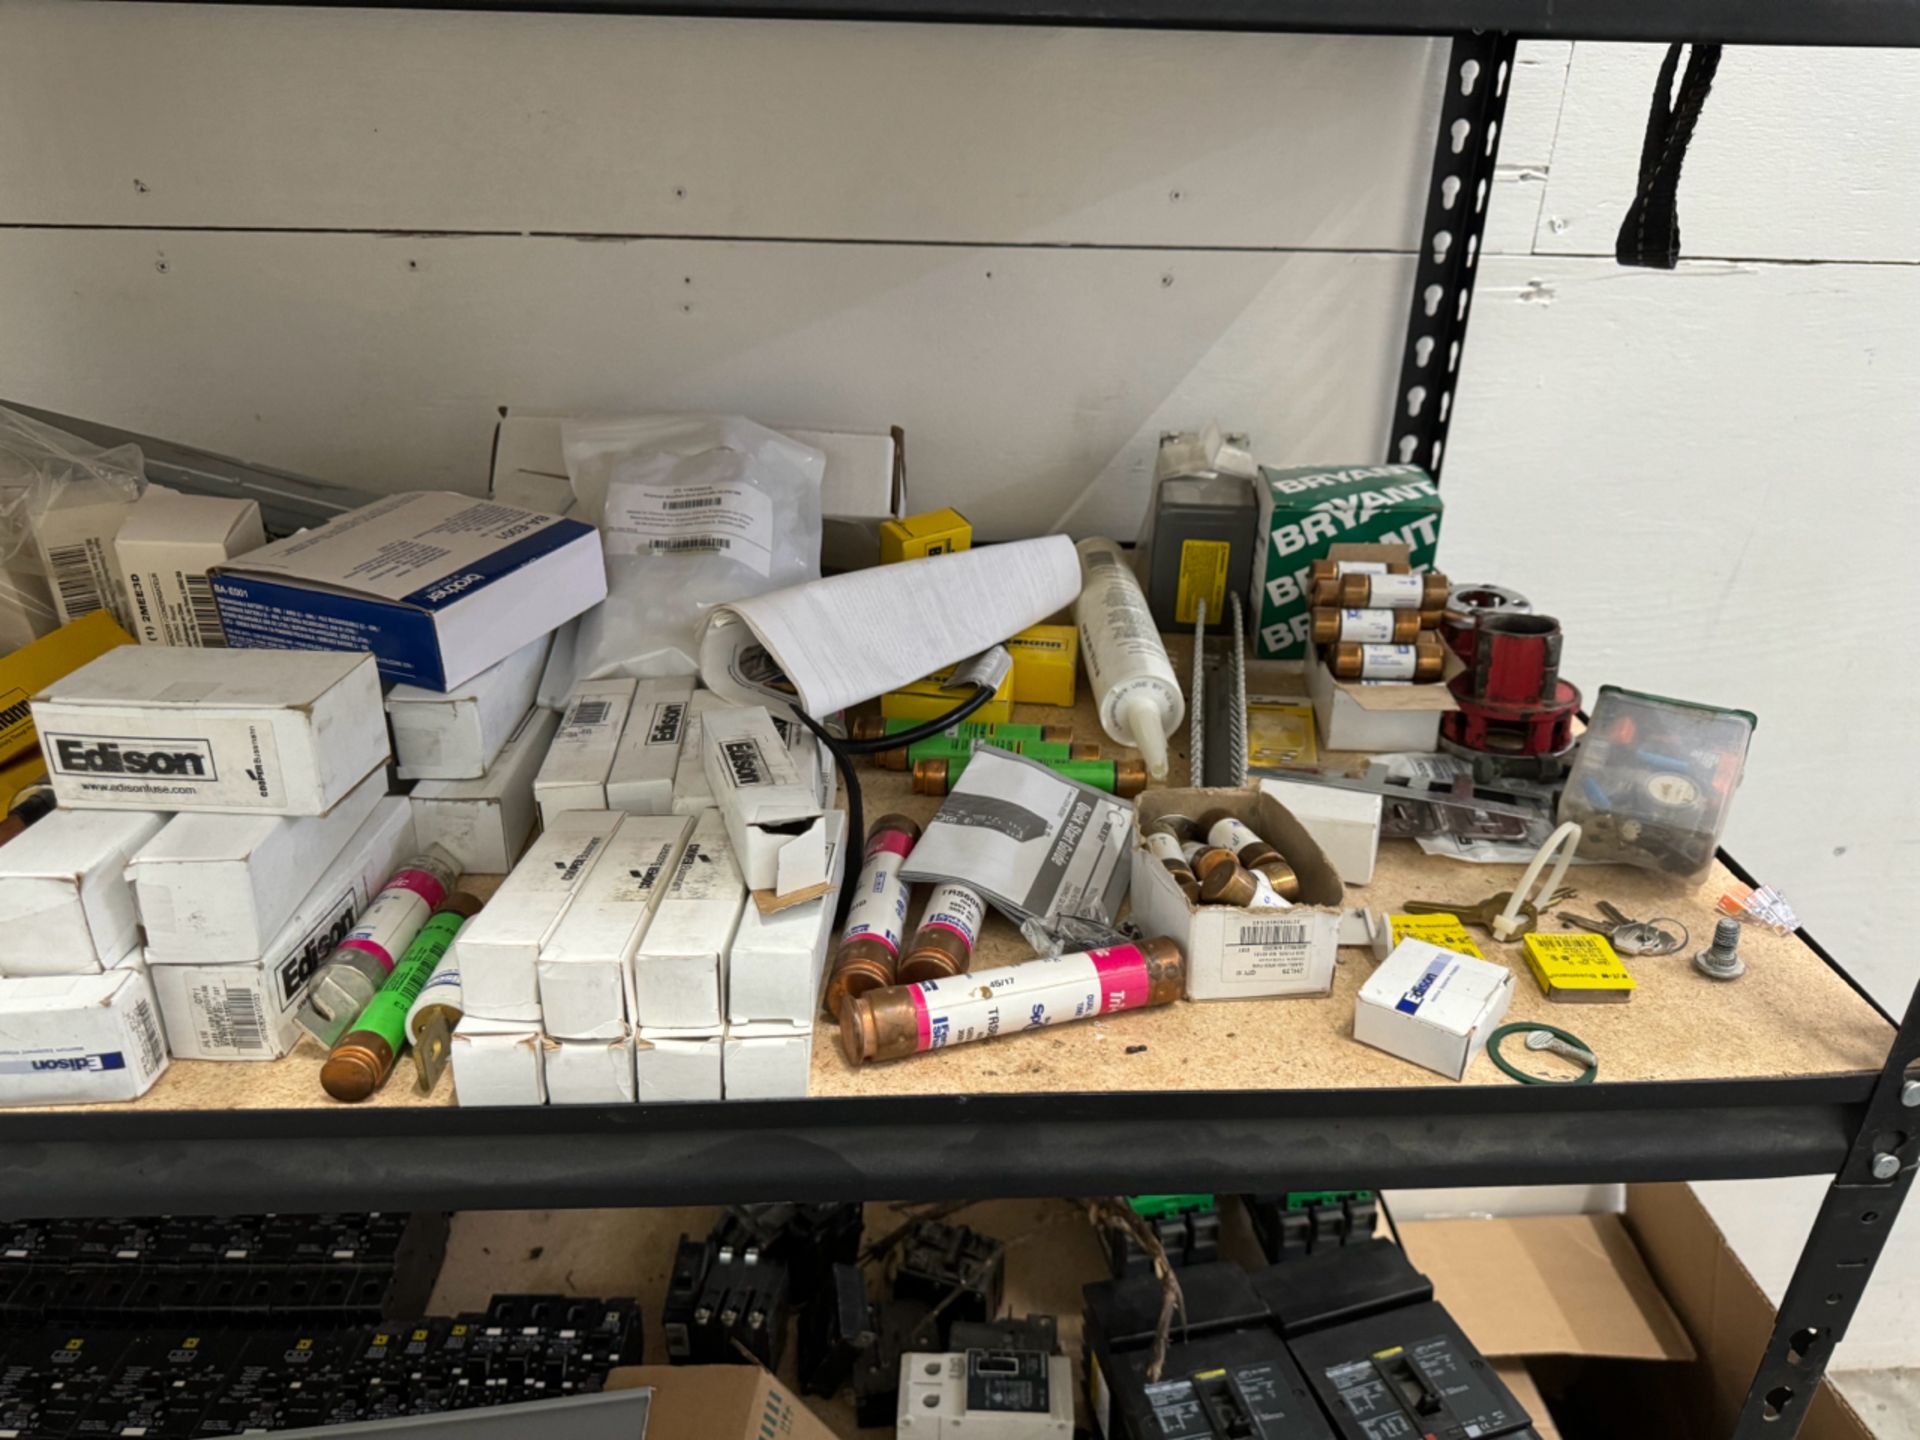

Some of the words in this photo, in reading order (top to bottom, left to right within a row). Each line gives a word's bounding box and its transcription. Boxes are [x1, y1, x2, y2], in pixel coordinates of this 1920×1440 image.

[1273, 465, 1422, 494] BRYANT
[1272, 480, 1438, 557] BRYANT
[130, 573, 153, 624] 2MEE3D
[426, 573, 485, 602] brother
[651, 704, 682, 742] Edison
[56, 739, 207, 776] Edison
[726, 741, 760, 784] Edison
[81, 783, 198, 796] www.edisonfuse.com
[258, 764, 269, 798] COOPER
[1070, 801, 1092, 825] Quick
[1061, 822, 1082, 845] Start
[1051, 840, 1072, 866] Guide
[281, 905, 355, 1001] Edison
[989, 977, 1014, 988] 45/17
[1405, 973, 1438, 1004] Edison
[32, 1055, 104, 1072] Edison
